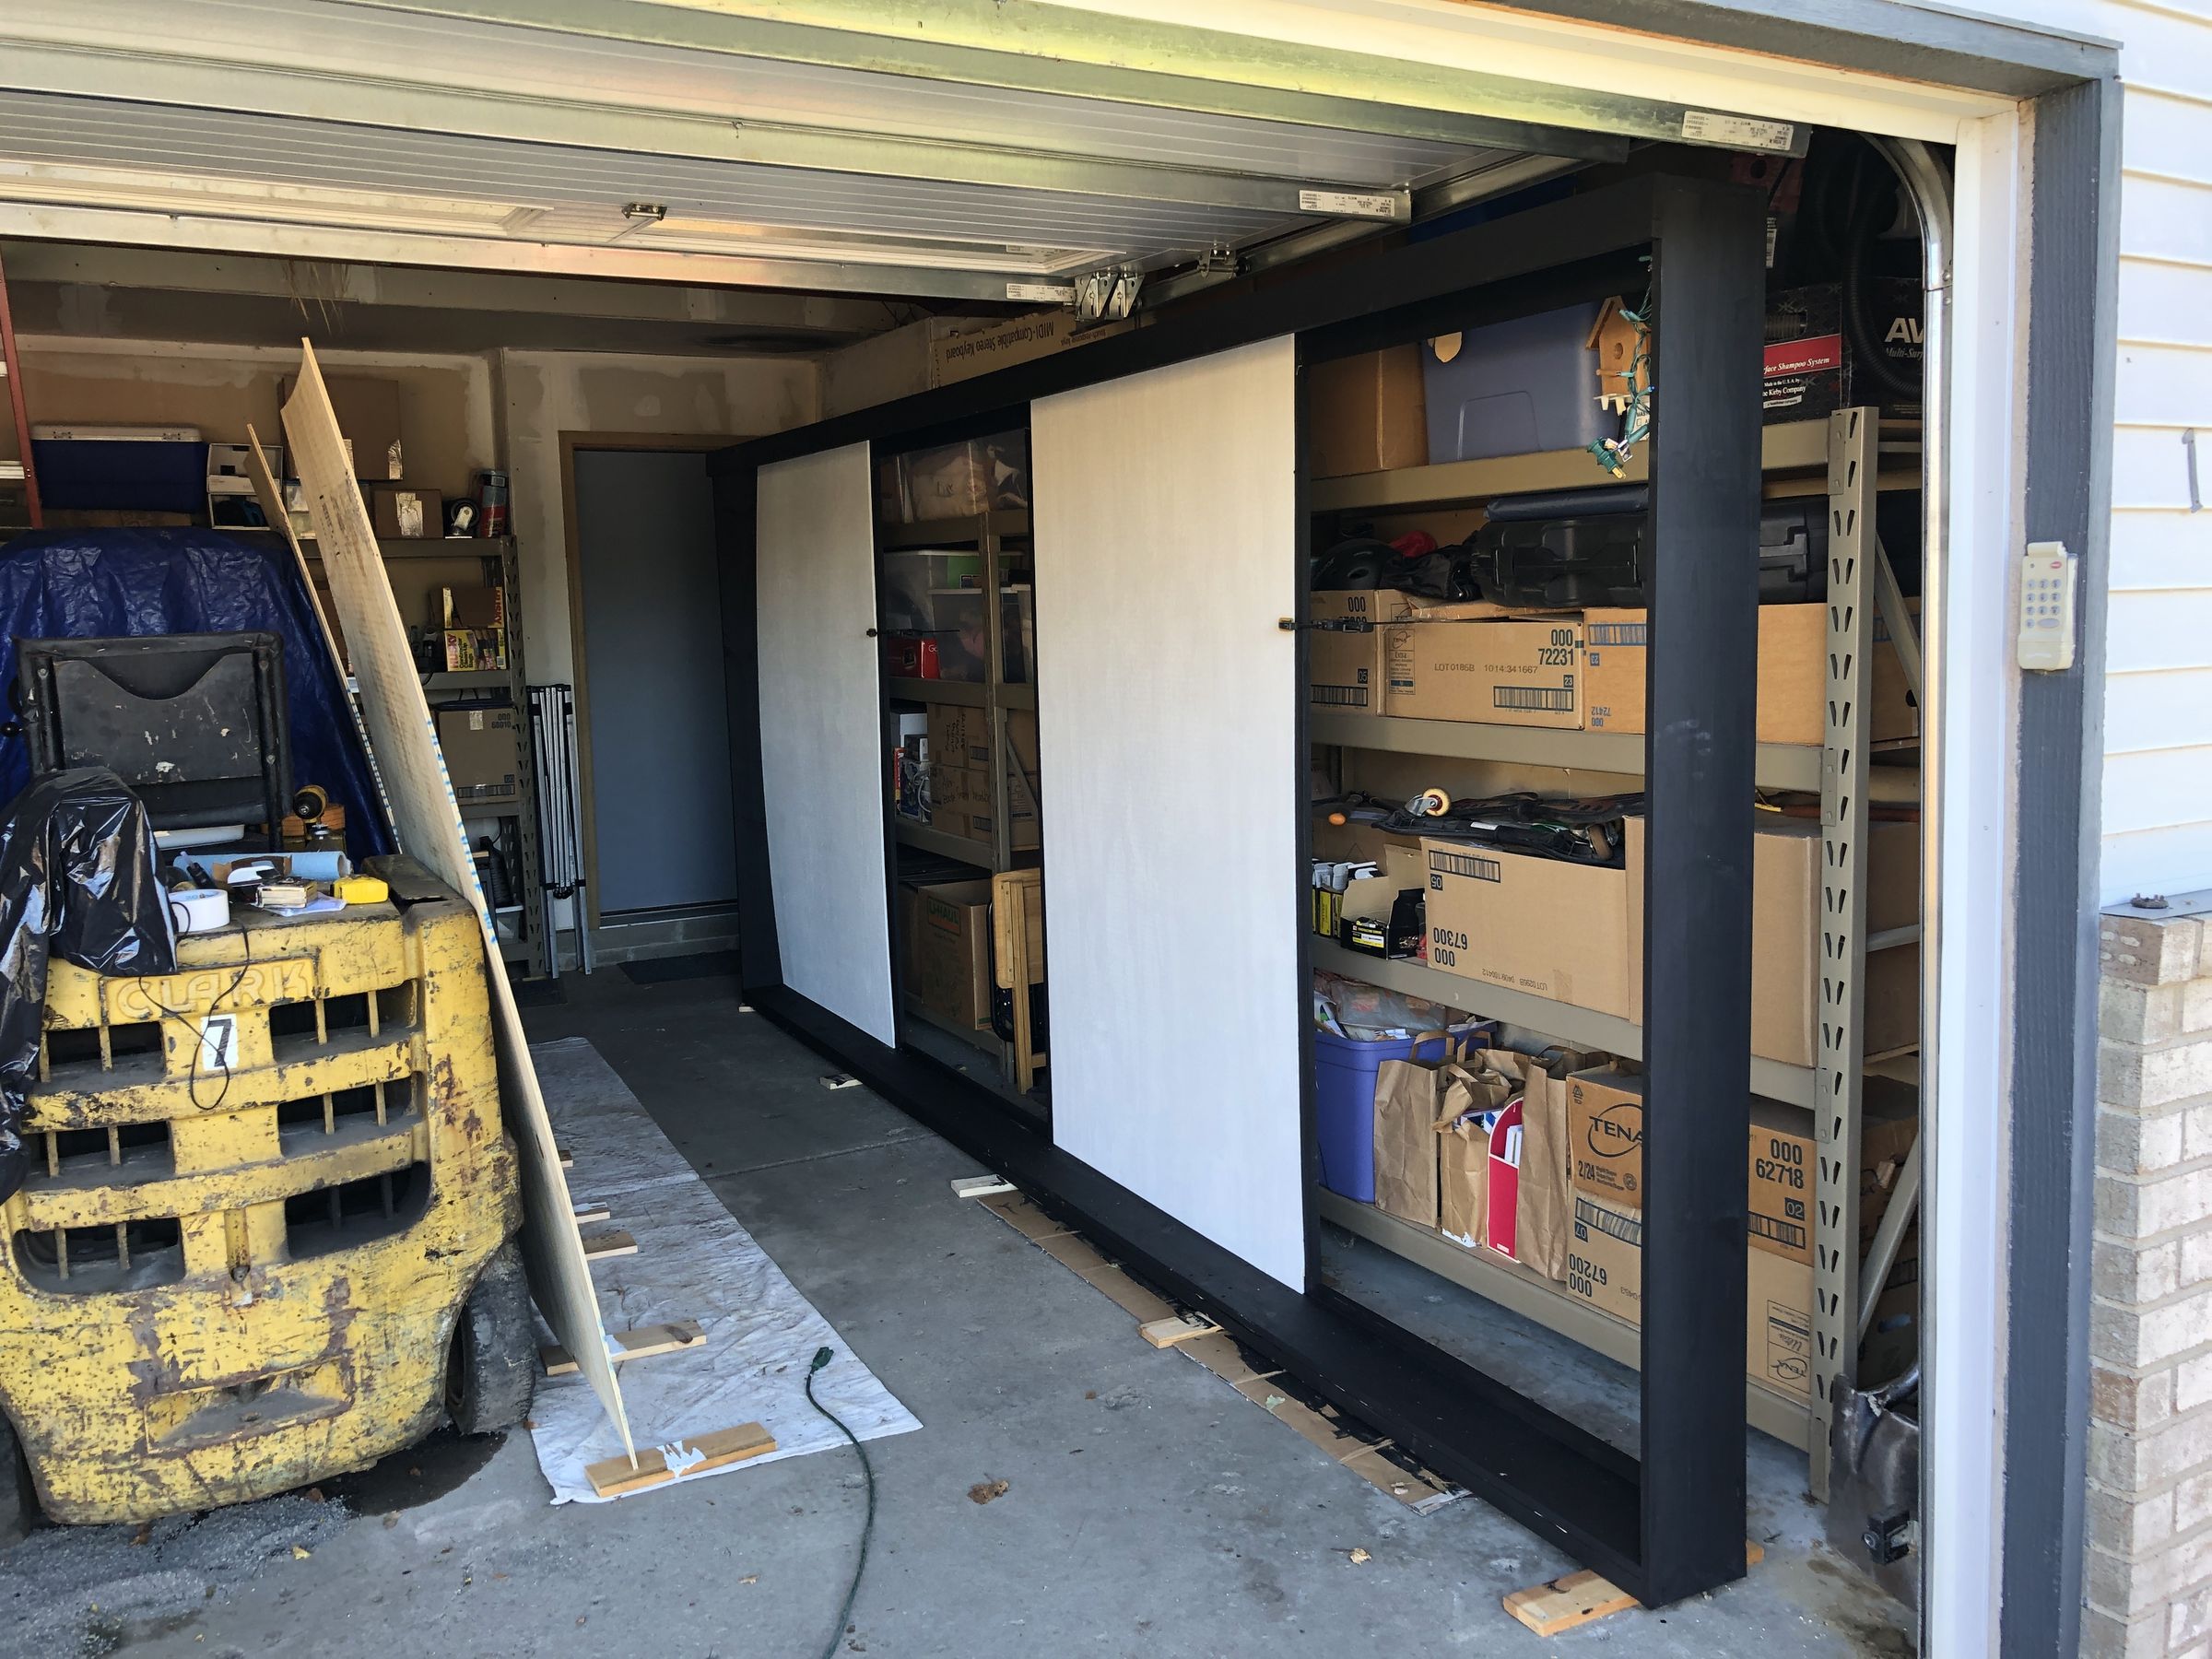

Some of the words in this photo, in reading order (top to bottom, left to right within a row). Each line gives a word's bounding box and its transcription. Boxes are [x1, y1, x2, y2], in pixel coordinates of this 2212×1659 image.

[946, 341, 975, 363] Keyboard
[976, 336, 995, 352] Stereo
[1778, 360, 1806, 371] Shampoo
[1806, 358, 1830, 367] System
[1769, 388, 1782, 396] Kirby
[1783, 386, 1806, 394] Company
[1347, 596, 1366, 612] 000
[1550, 629, 1573, 646] 000
[1538, 648, 1574, 666] 72231
[1358, 670, 1368, 682] 05
[1564, 677, 1572, 686] 23
[1430, 876, 1442, 889] 05
[1433, 926, 1468, 950] 67300
[1434, 947, 1455, 967] 000
[117, 962, 309, 1019] CLARK
[208, 1018, 232, 1068] 7
[1588, 1115, 1642, 1147] TENA
[1771, 1137, 1803, 1166] 000
[1756, 1158, 1805, 1190] 62718
[1786, 1202, 1804, 1218] 02
[1576, 1224, 1586, 1240] 07
[1569, 1253, 1607, 1286] 67200
[1570, 1272, 1593, 1298] 000
